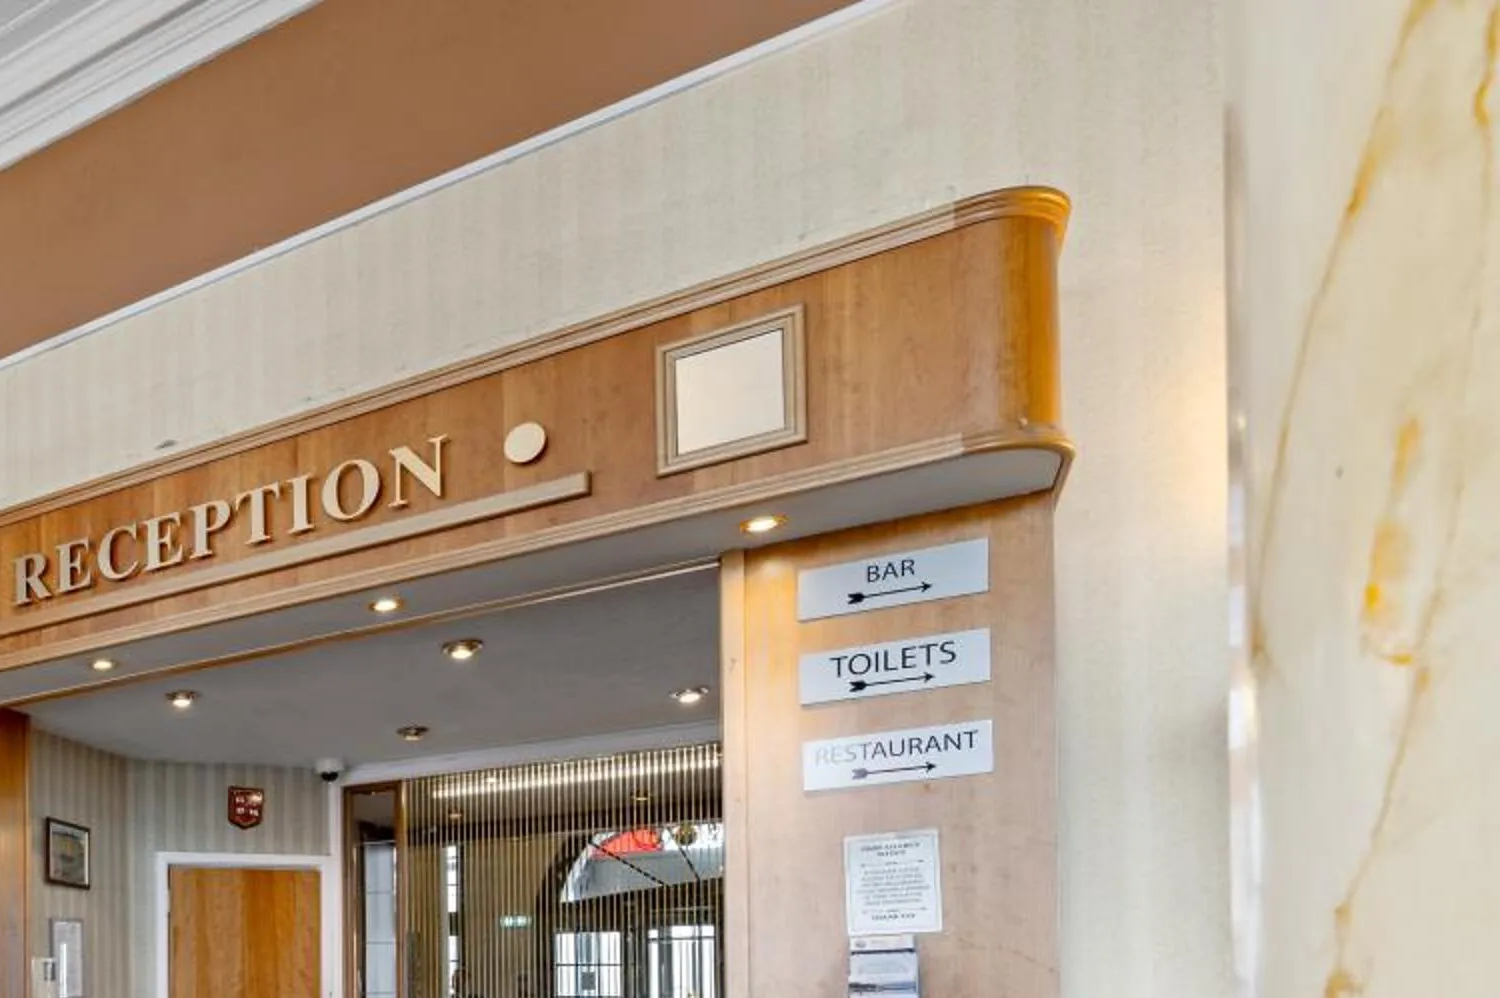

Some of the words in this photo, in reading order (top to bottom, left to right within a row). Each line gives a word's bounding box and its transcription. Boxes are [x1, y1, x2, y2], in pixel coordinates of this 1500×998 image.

[13, 433, 450, 605] RECEPTION
[866, 559, 915, 583] BAR
[830, 641, 957, 678] TOILETS
[815, 730, 978, 765] RESTAURANT
